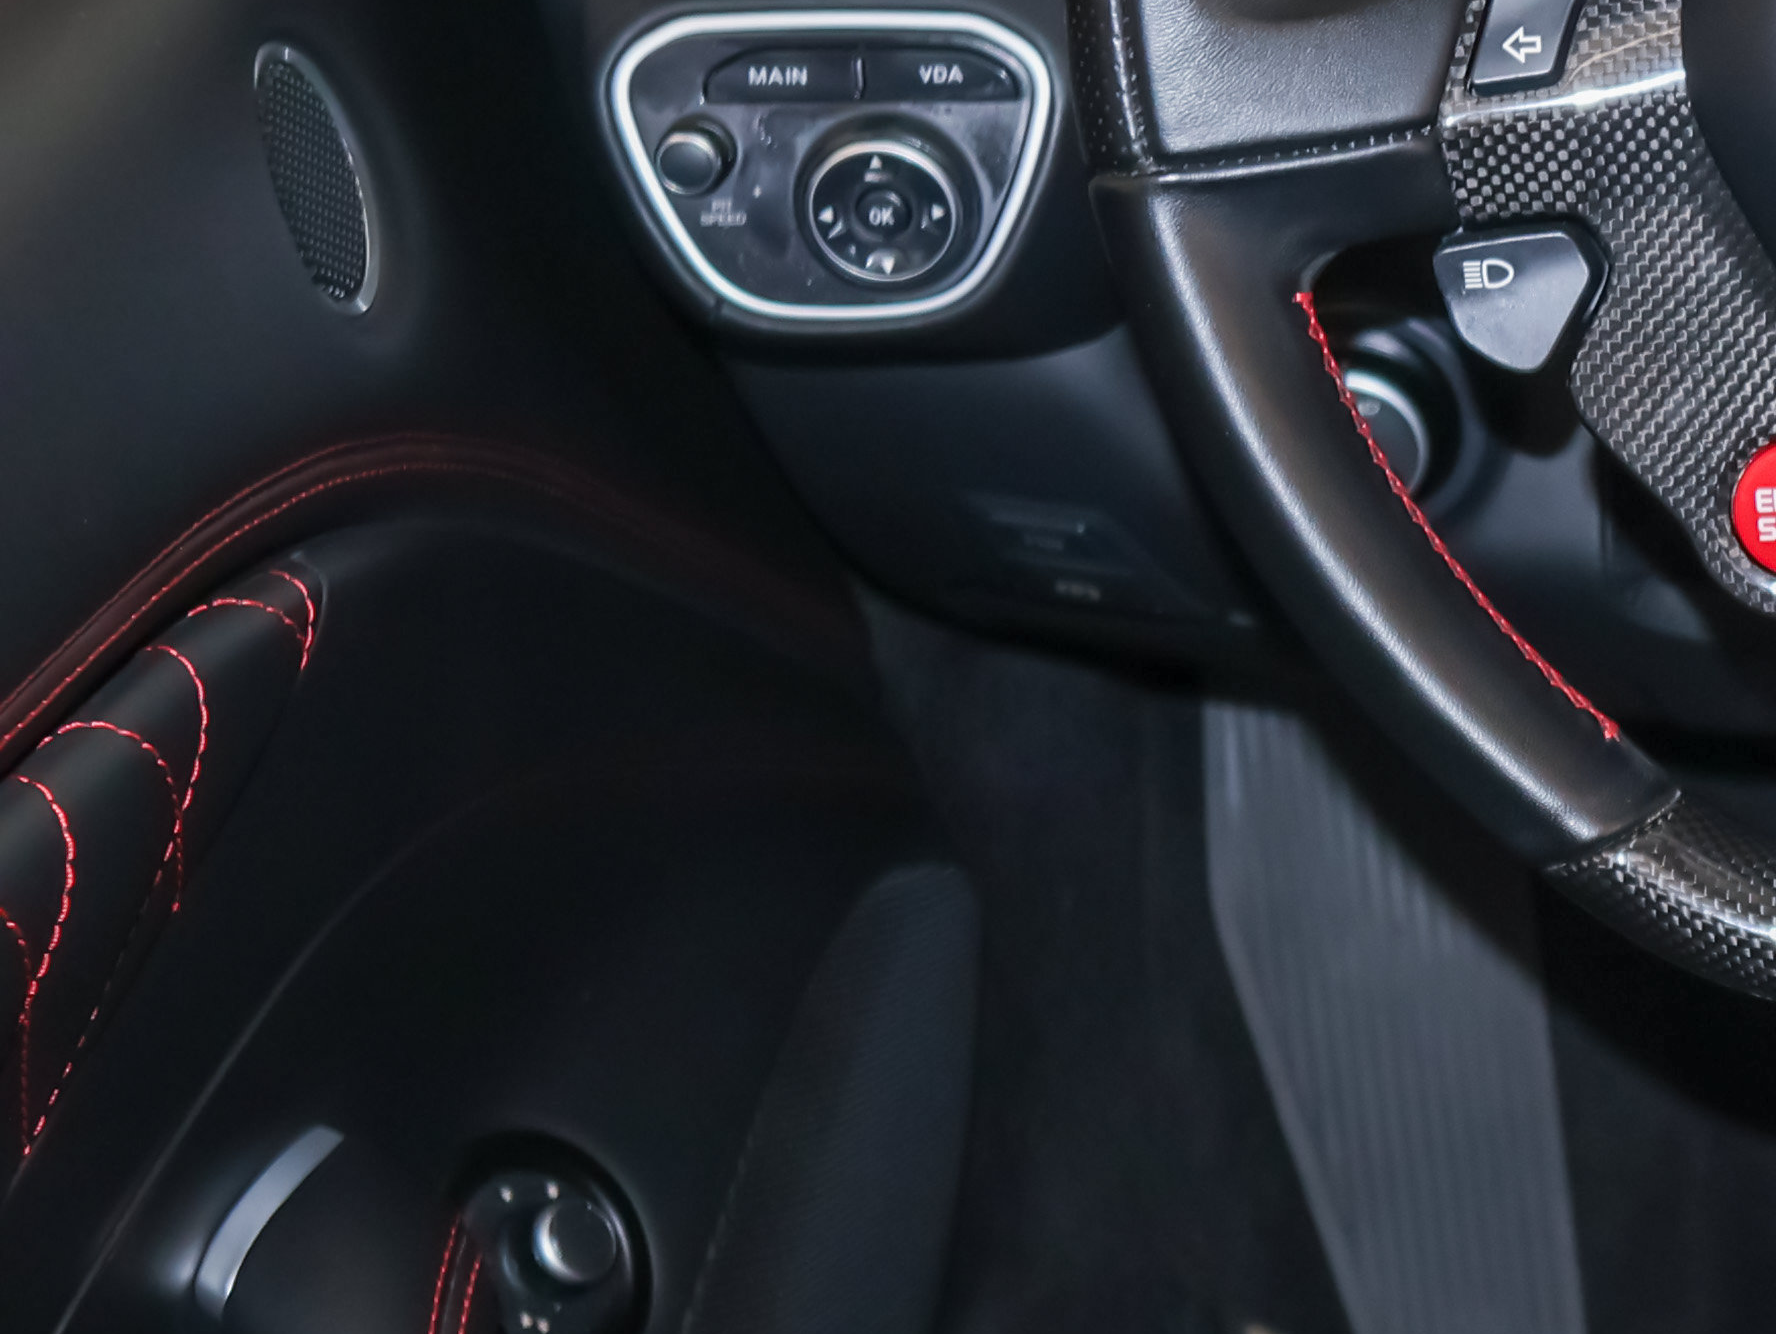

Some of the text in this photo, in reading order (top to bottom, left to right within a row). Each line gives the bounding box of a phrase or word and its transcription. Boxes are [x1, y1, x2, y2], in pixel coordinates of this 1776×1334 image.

[748, 65, 808, 88] MAIN
[919, 64, 964, 85] VDA
[868, 206, 896, 226] OK
